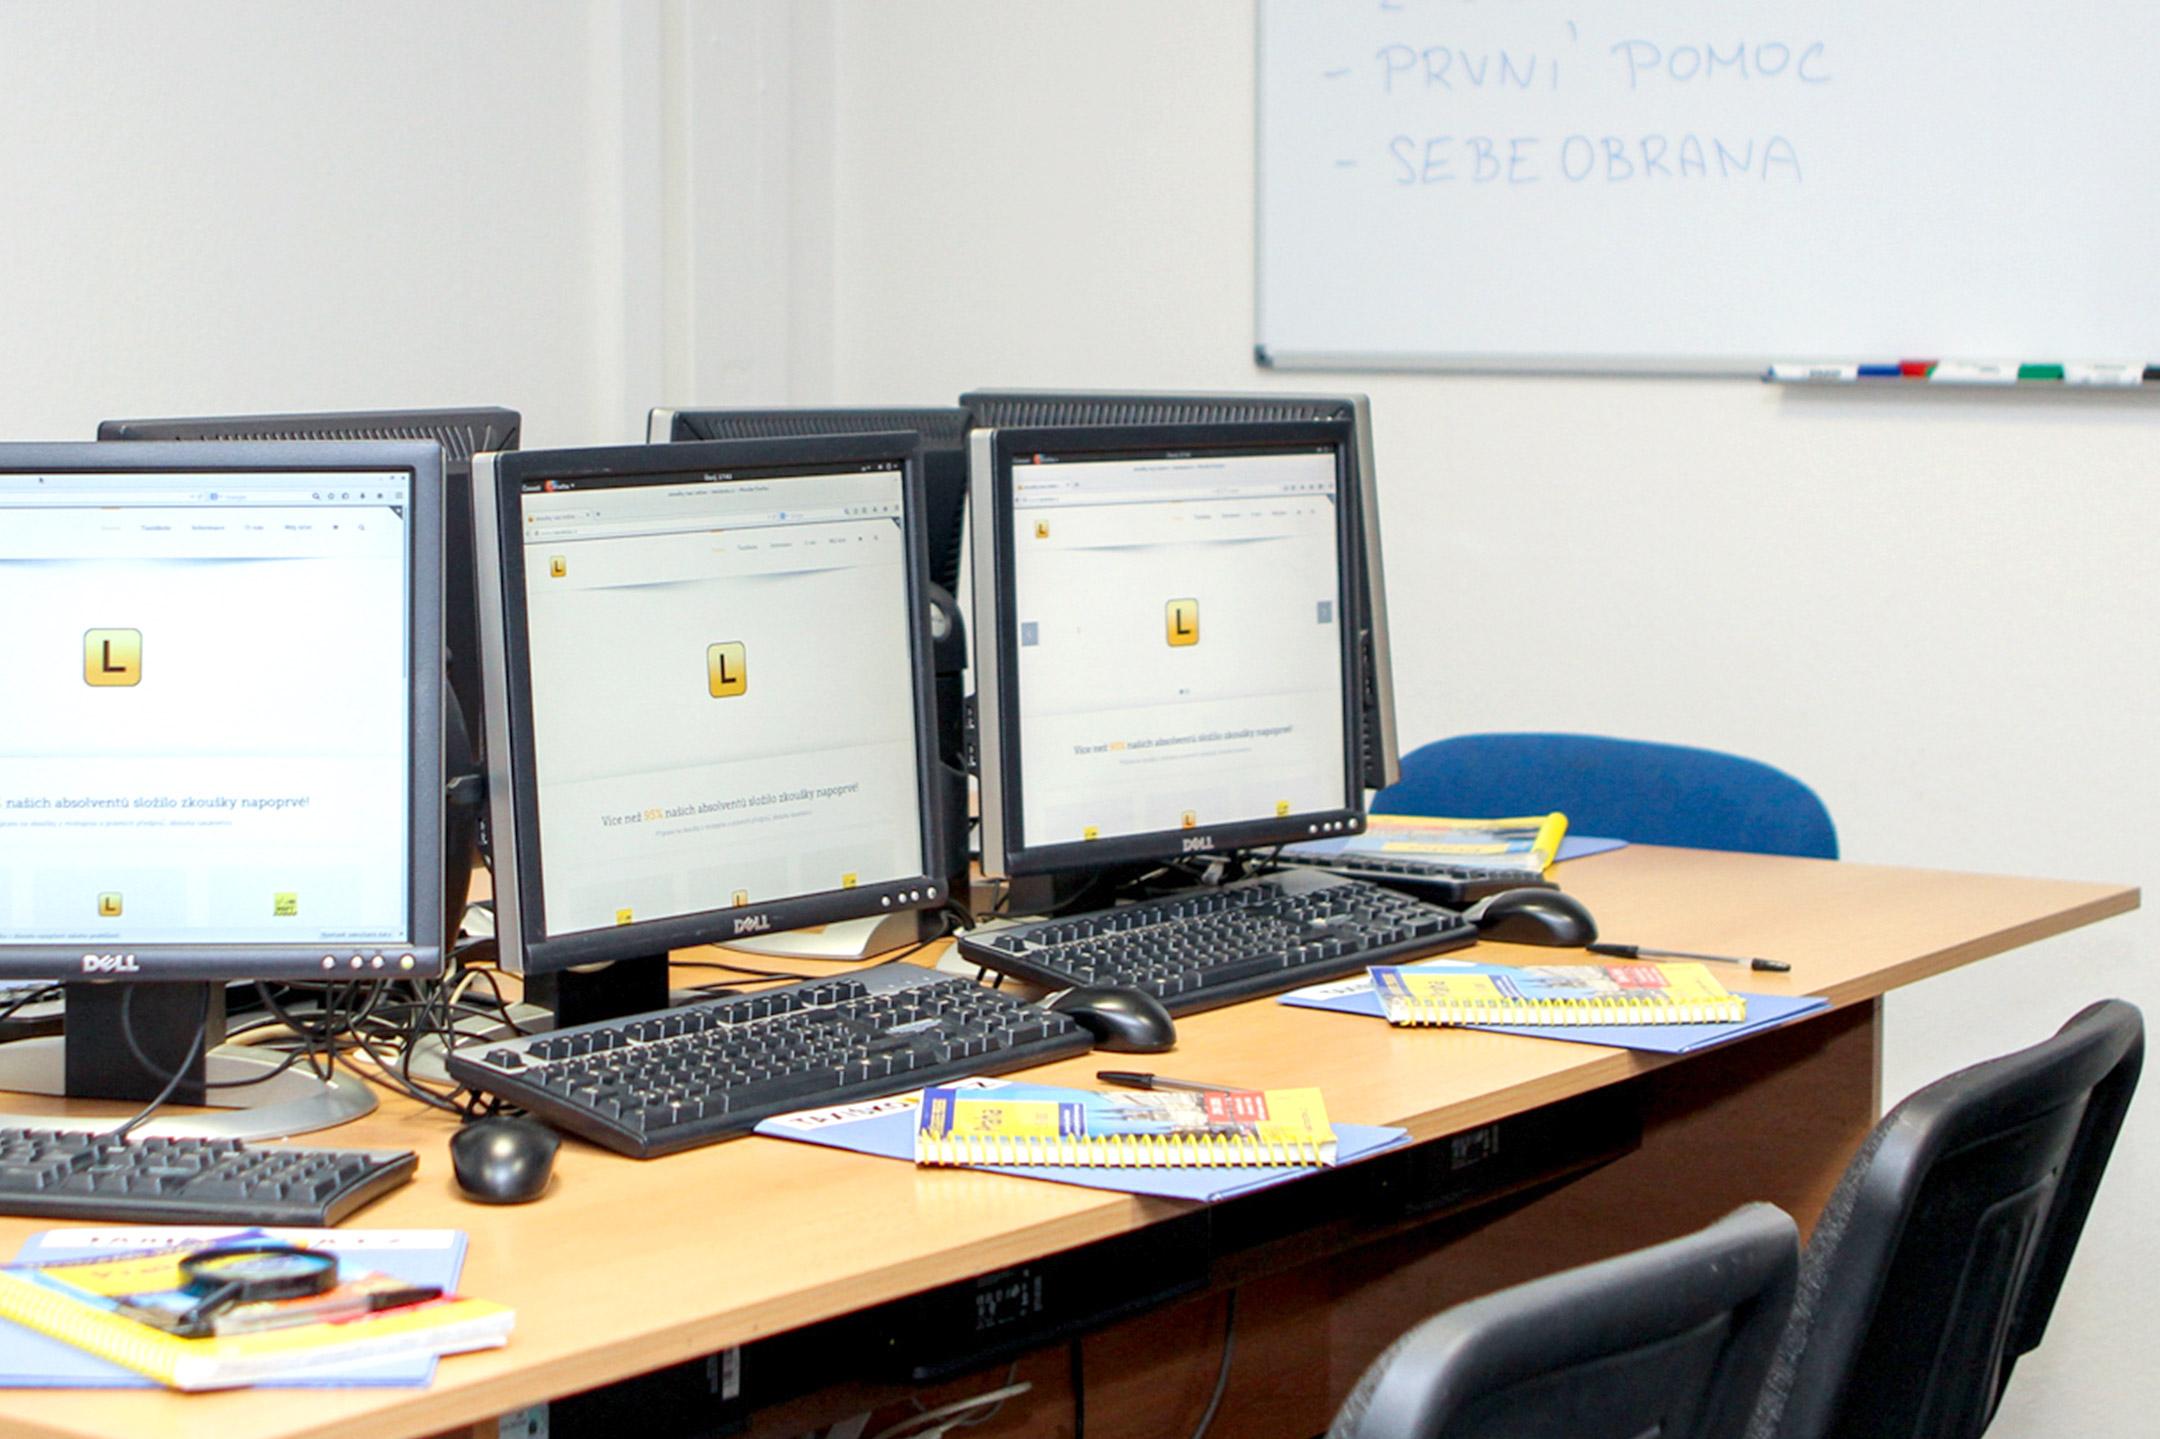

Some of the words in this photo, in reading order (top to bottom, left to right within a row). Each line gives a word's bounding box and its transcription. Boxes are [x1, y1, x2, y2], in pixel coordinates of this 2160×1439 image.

[1610, 40, 1832, 91] POMOC
[1176, 608, 1191, 635] L
[101, 639, 127, 673] L
[719, 653, 737, 684] L
[6, 796, 51, 809] našich
[54, 796, 129, 809] absolventů
[133, 796, 178, 809] složilo
[180, 796, 237, 810] zkoušky
[1182, 836, 1215, 852] DELL
[105, 897, 117, 911] L
[733, 914, 771, 934] DELL
[82, 954, 140, 972] DELL
